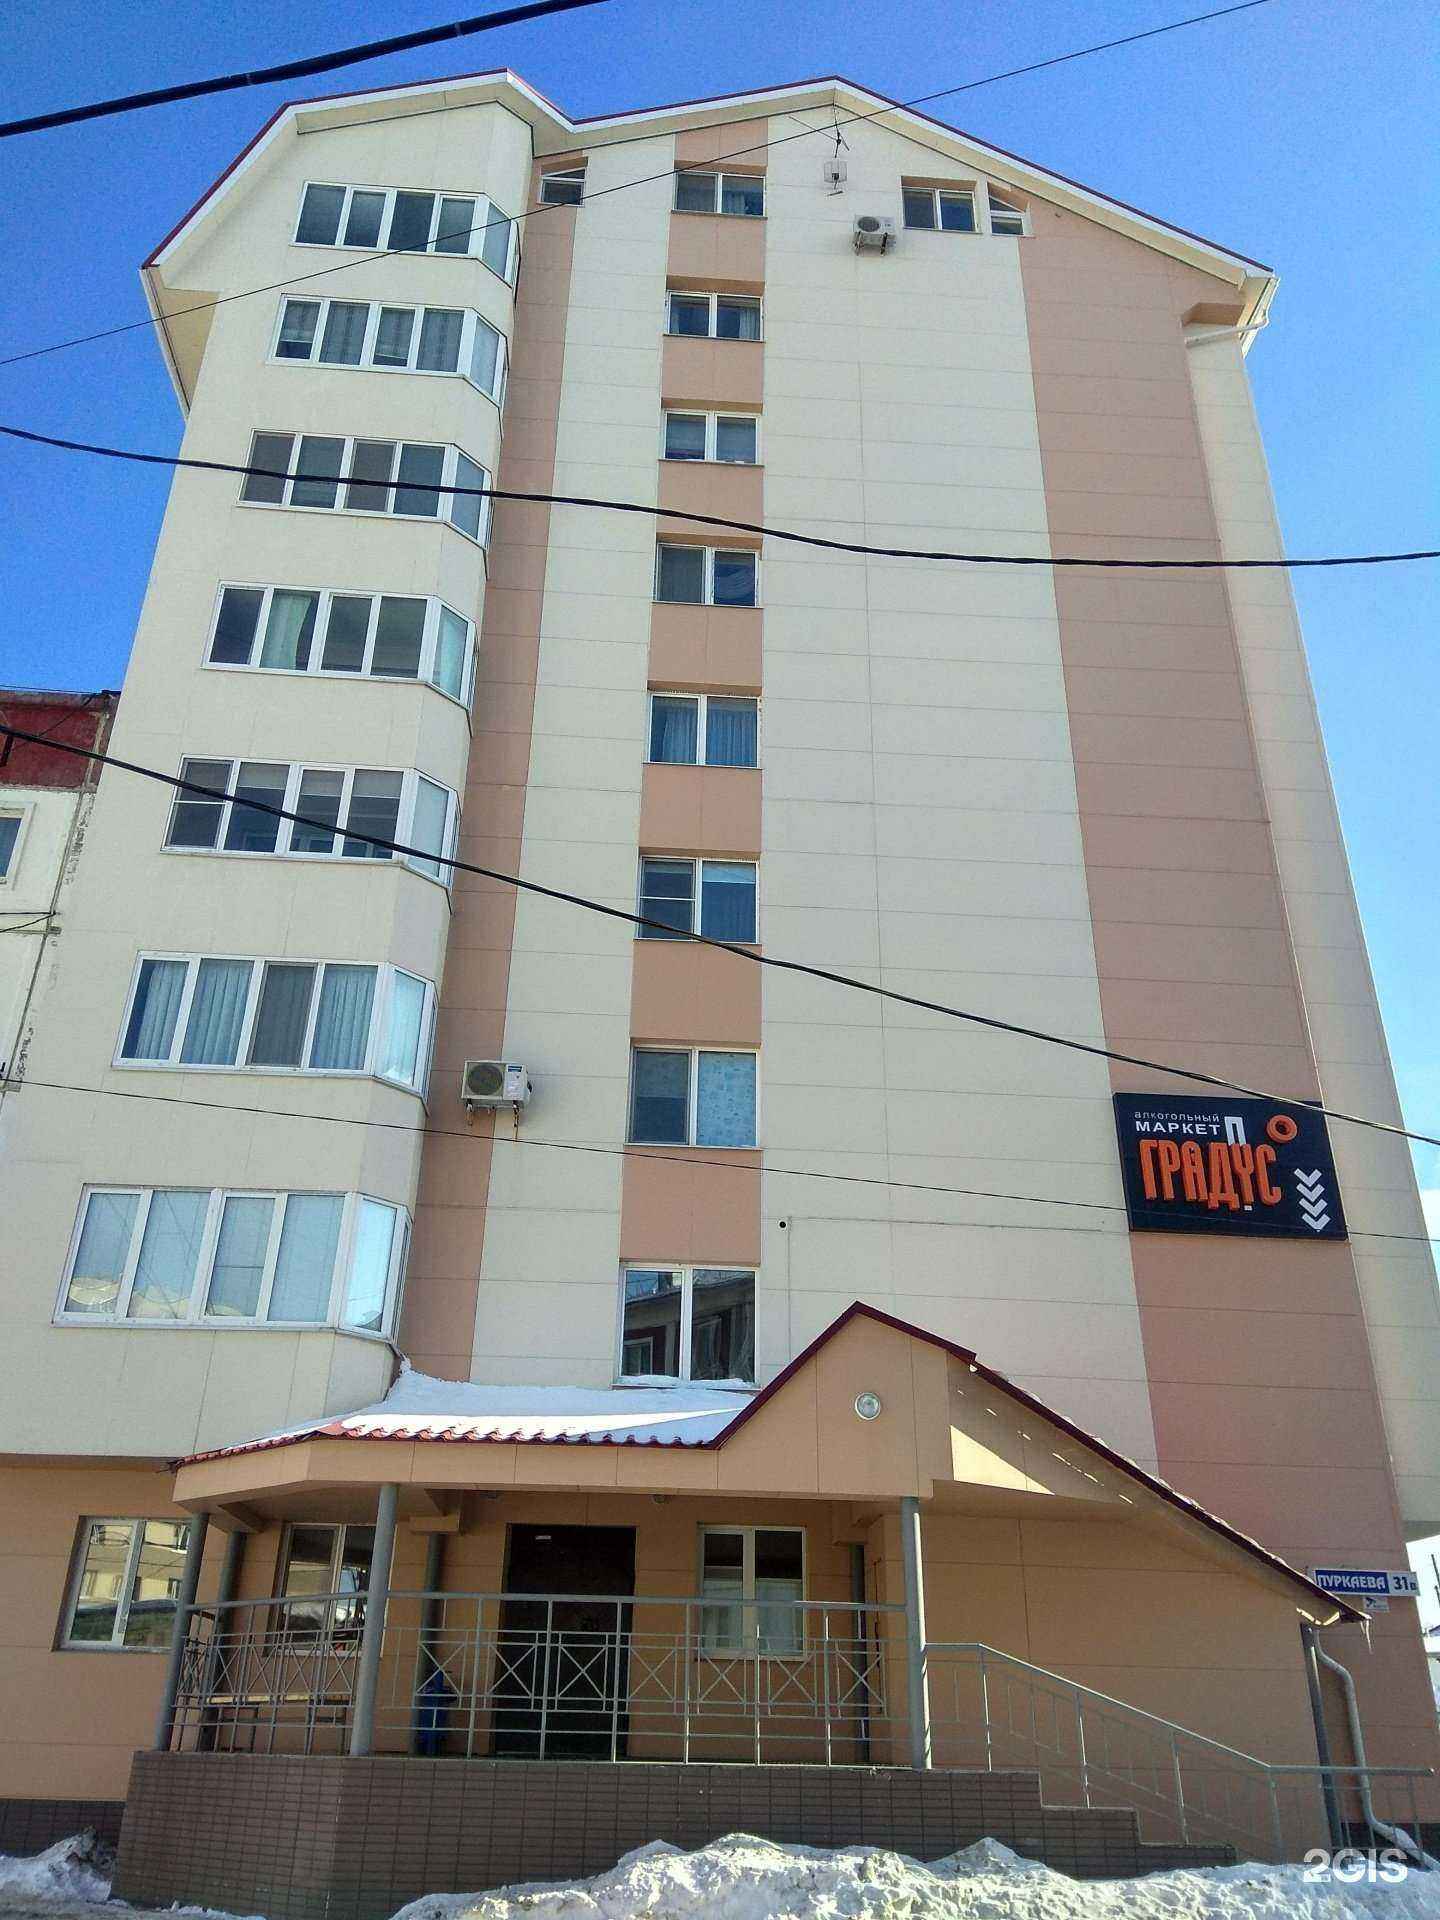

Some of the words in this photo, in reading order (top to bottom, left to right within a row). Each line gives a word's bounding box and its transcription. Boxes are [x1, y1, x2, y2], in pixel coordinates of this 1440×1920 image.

[1134, 1120, 1221, 1136] МАРКЕТ
[1138, 1139, 1282, 1211] ГРАДУС
[1317, 1574, 1386, 1589] ПУРКАЕВА
